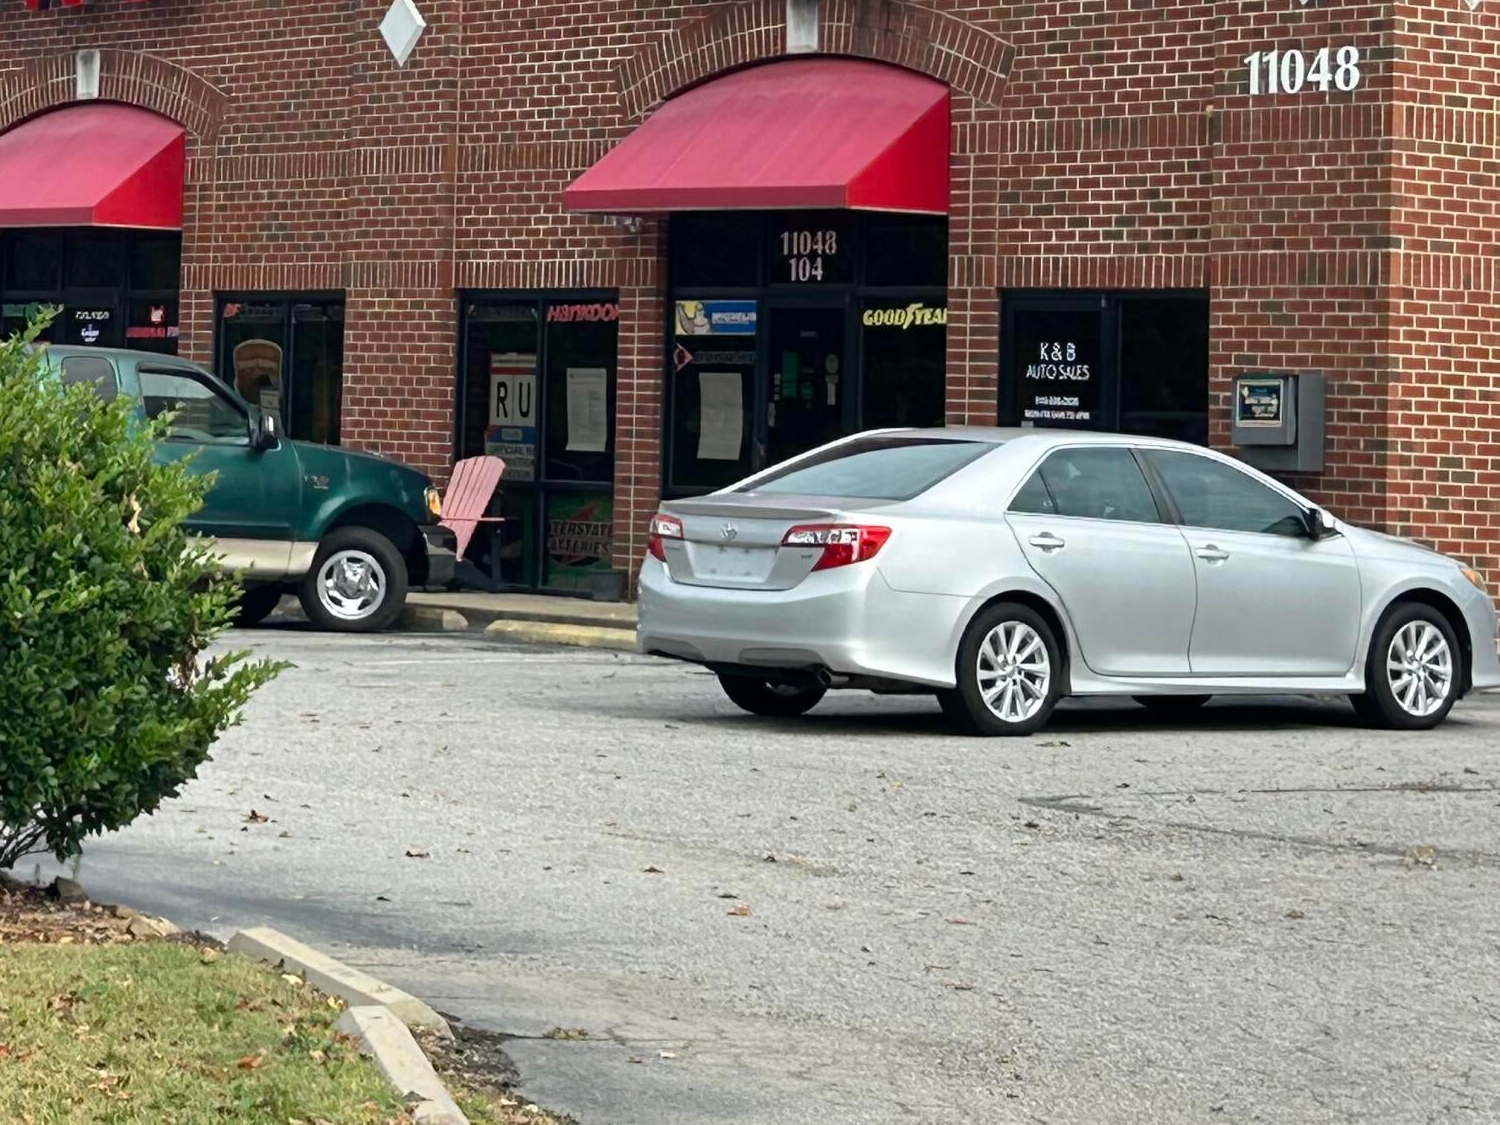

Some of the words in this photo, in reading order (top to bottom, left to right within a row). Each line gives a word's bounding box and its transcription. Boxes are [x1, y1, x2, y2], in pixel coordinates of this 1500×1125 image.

[1244, 46, 1360, 95] 11048
[781, 230, 837, 255] 11048
[789, 257, 823, 282] 104
[1040, 342, 1049, 361] K
[1051, 342, 1063, 361] &
[1066, 342, 1076, 362] B
[1025, 364, 1057, 380] AUTO
